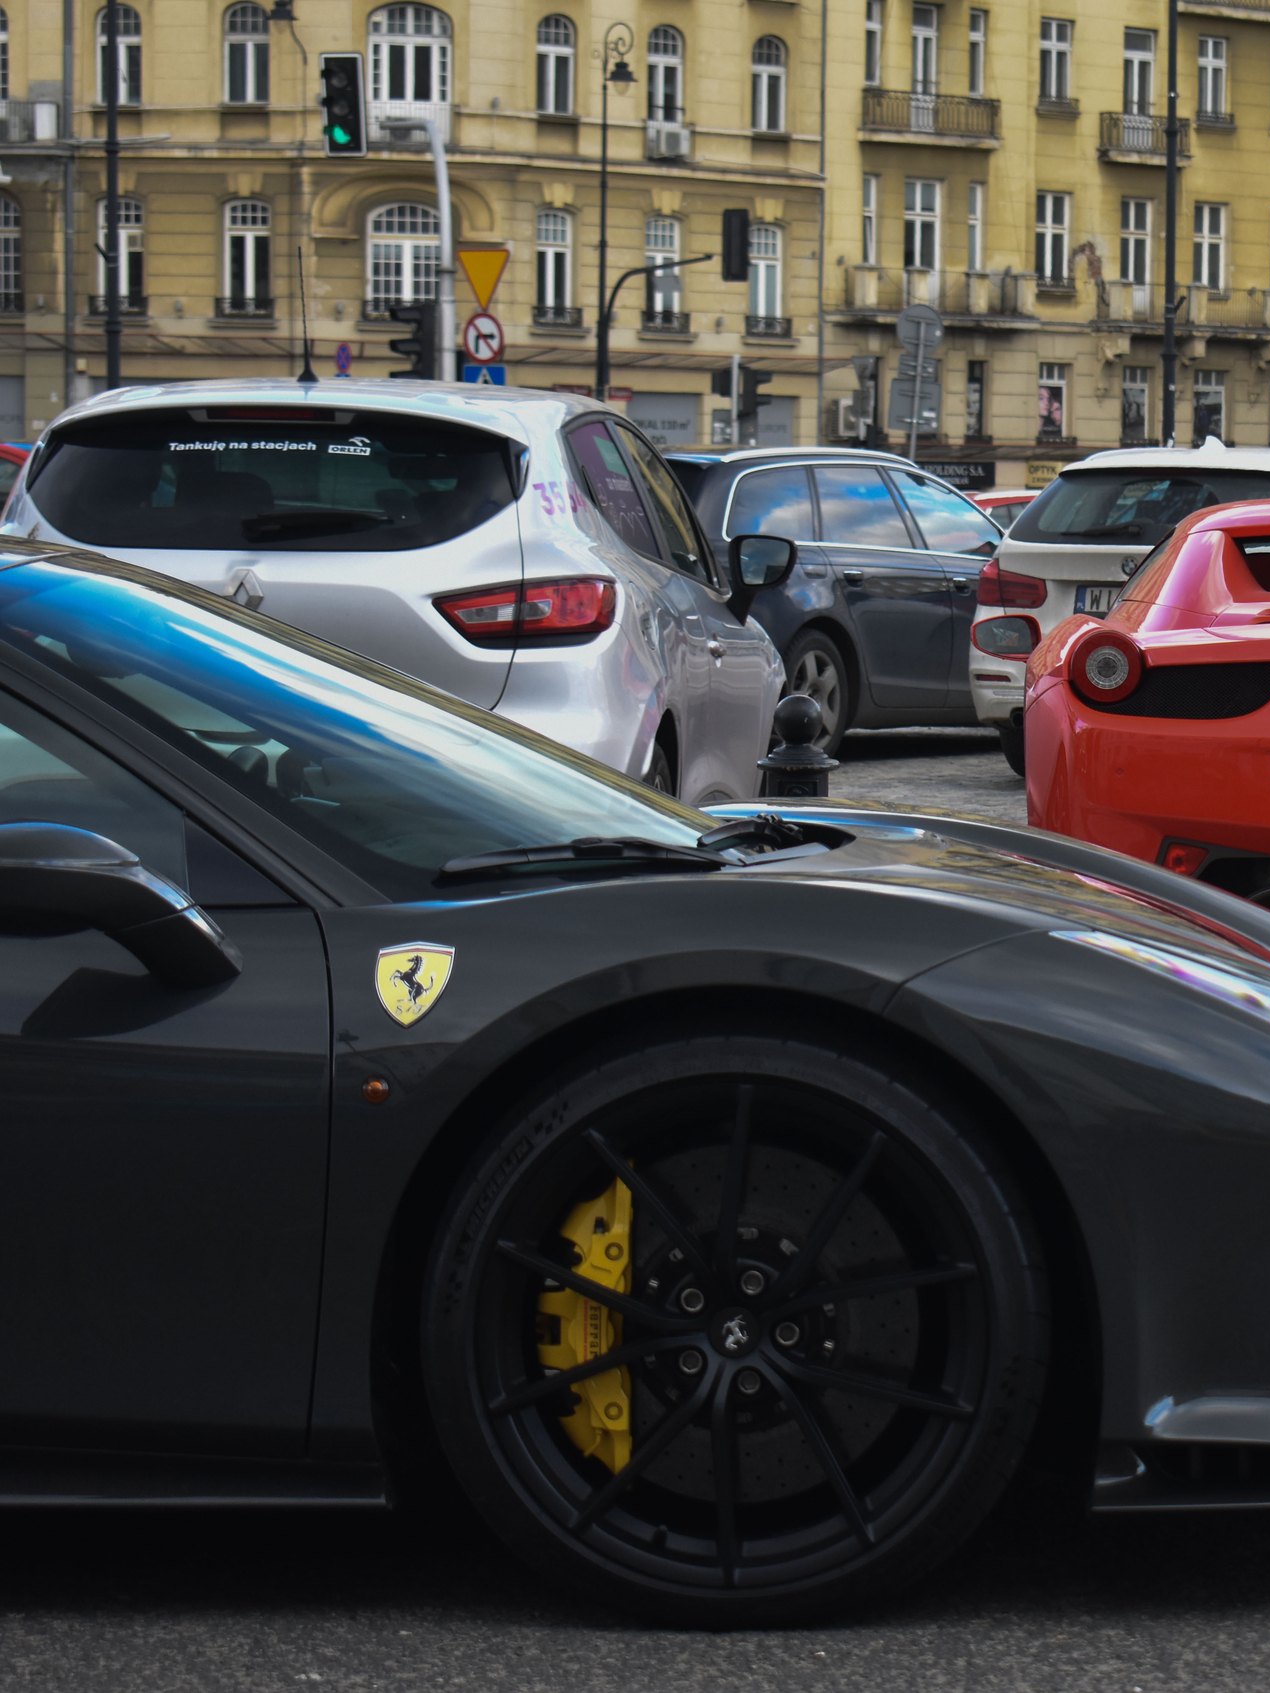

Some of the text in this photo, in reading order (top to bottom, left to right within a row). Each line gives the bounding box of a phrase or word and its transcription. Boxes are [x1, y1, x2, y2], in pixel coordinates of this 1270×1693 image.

[169, 440, 369, 455] Tankuję na stacjach ORLEN
[465, 1135, 534, 1239] MICHELIN
[589, 1305, 601, 1359] Ferrar
